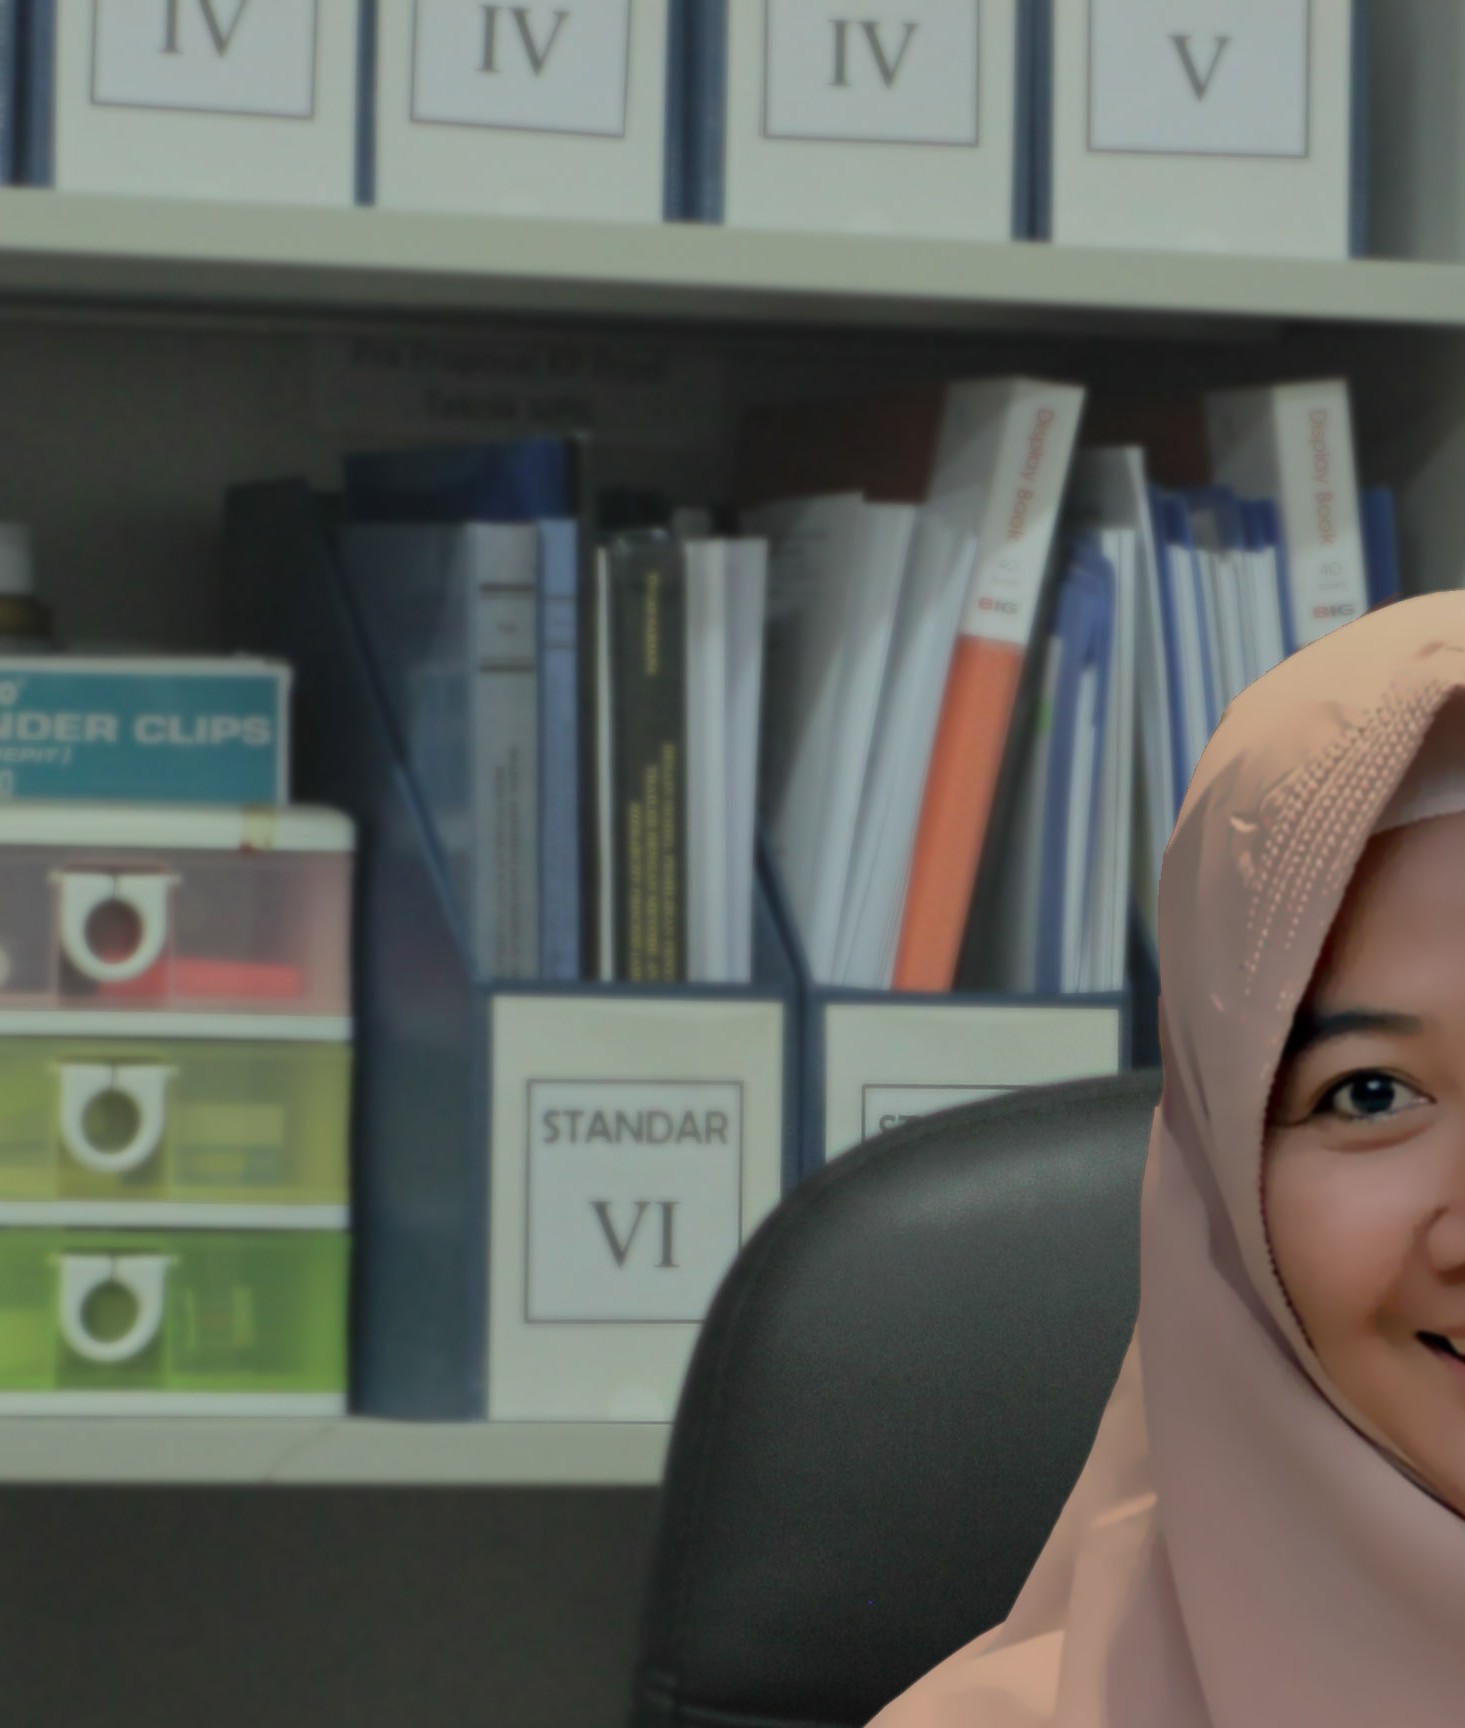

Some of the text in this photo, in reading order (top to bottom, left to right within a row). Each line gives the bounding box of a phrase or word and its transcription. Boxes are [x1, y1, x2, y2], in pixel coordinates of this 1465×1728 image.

[158, 0, 249, 58] IV
[477, 4, 569, 77] IV
[828, 19, 919, 91] IV
[1168, 35, 1231, 102] V
[1021, 407, 1056, 488] Display
[1307, 409, 1336, 545] Display Book
[1007, 488, 1036, 542] Book
[978, 596, 1019, 614] BIG
[1312, 603, 1355, 619] BIG
[134, 715, 271, 745] CLIPS
[543, 1108, 729, 1146] STANDAR
[590, 1199, 681, 1269] VI
